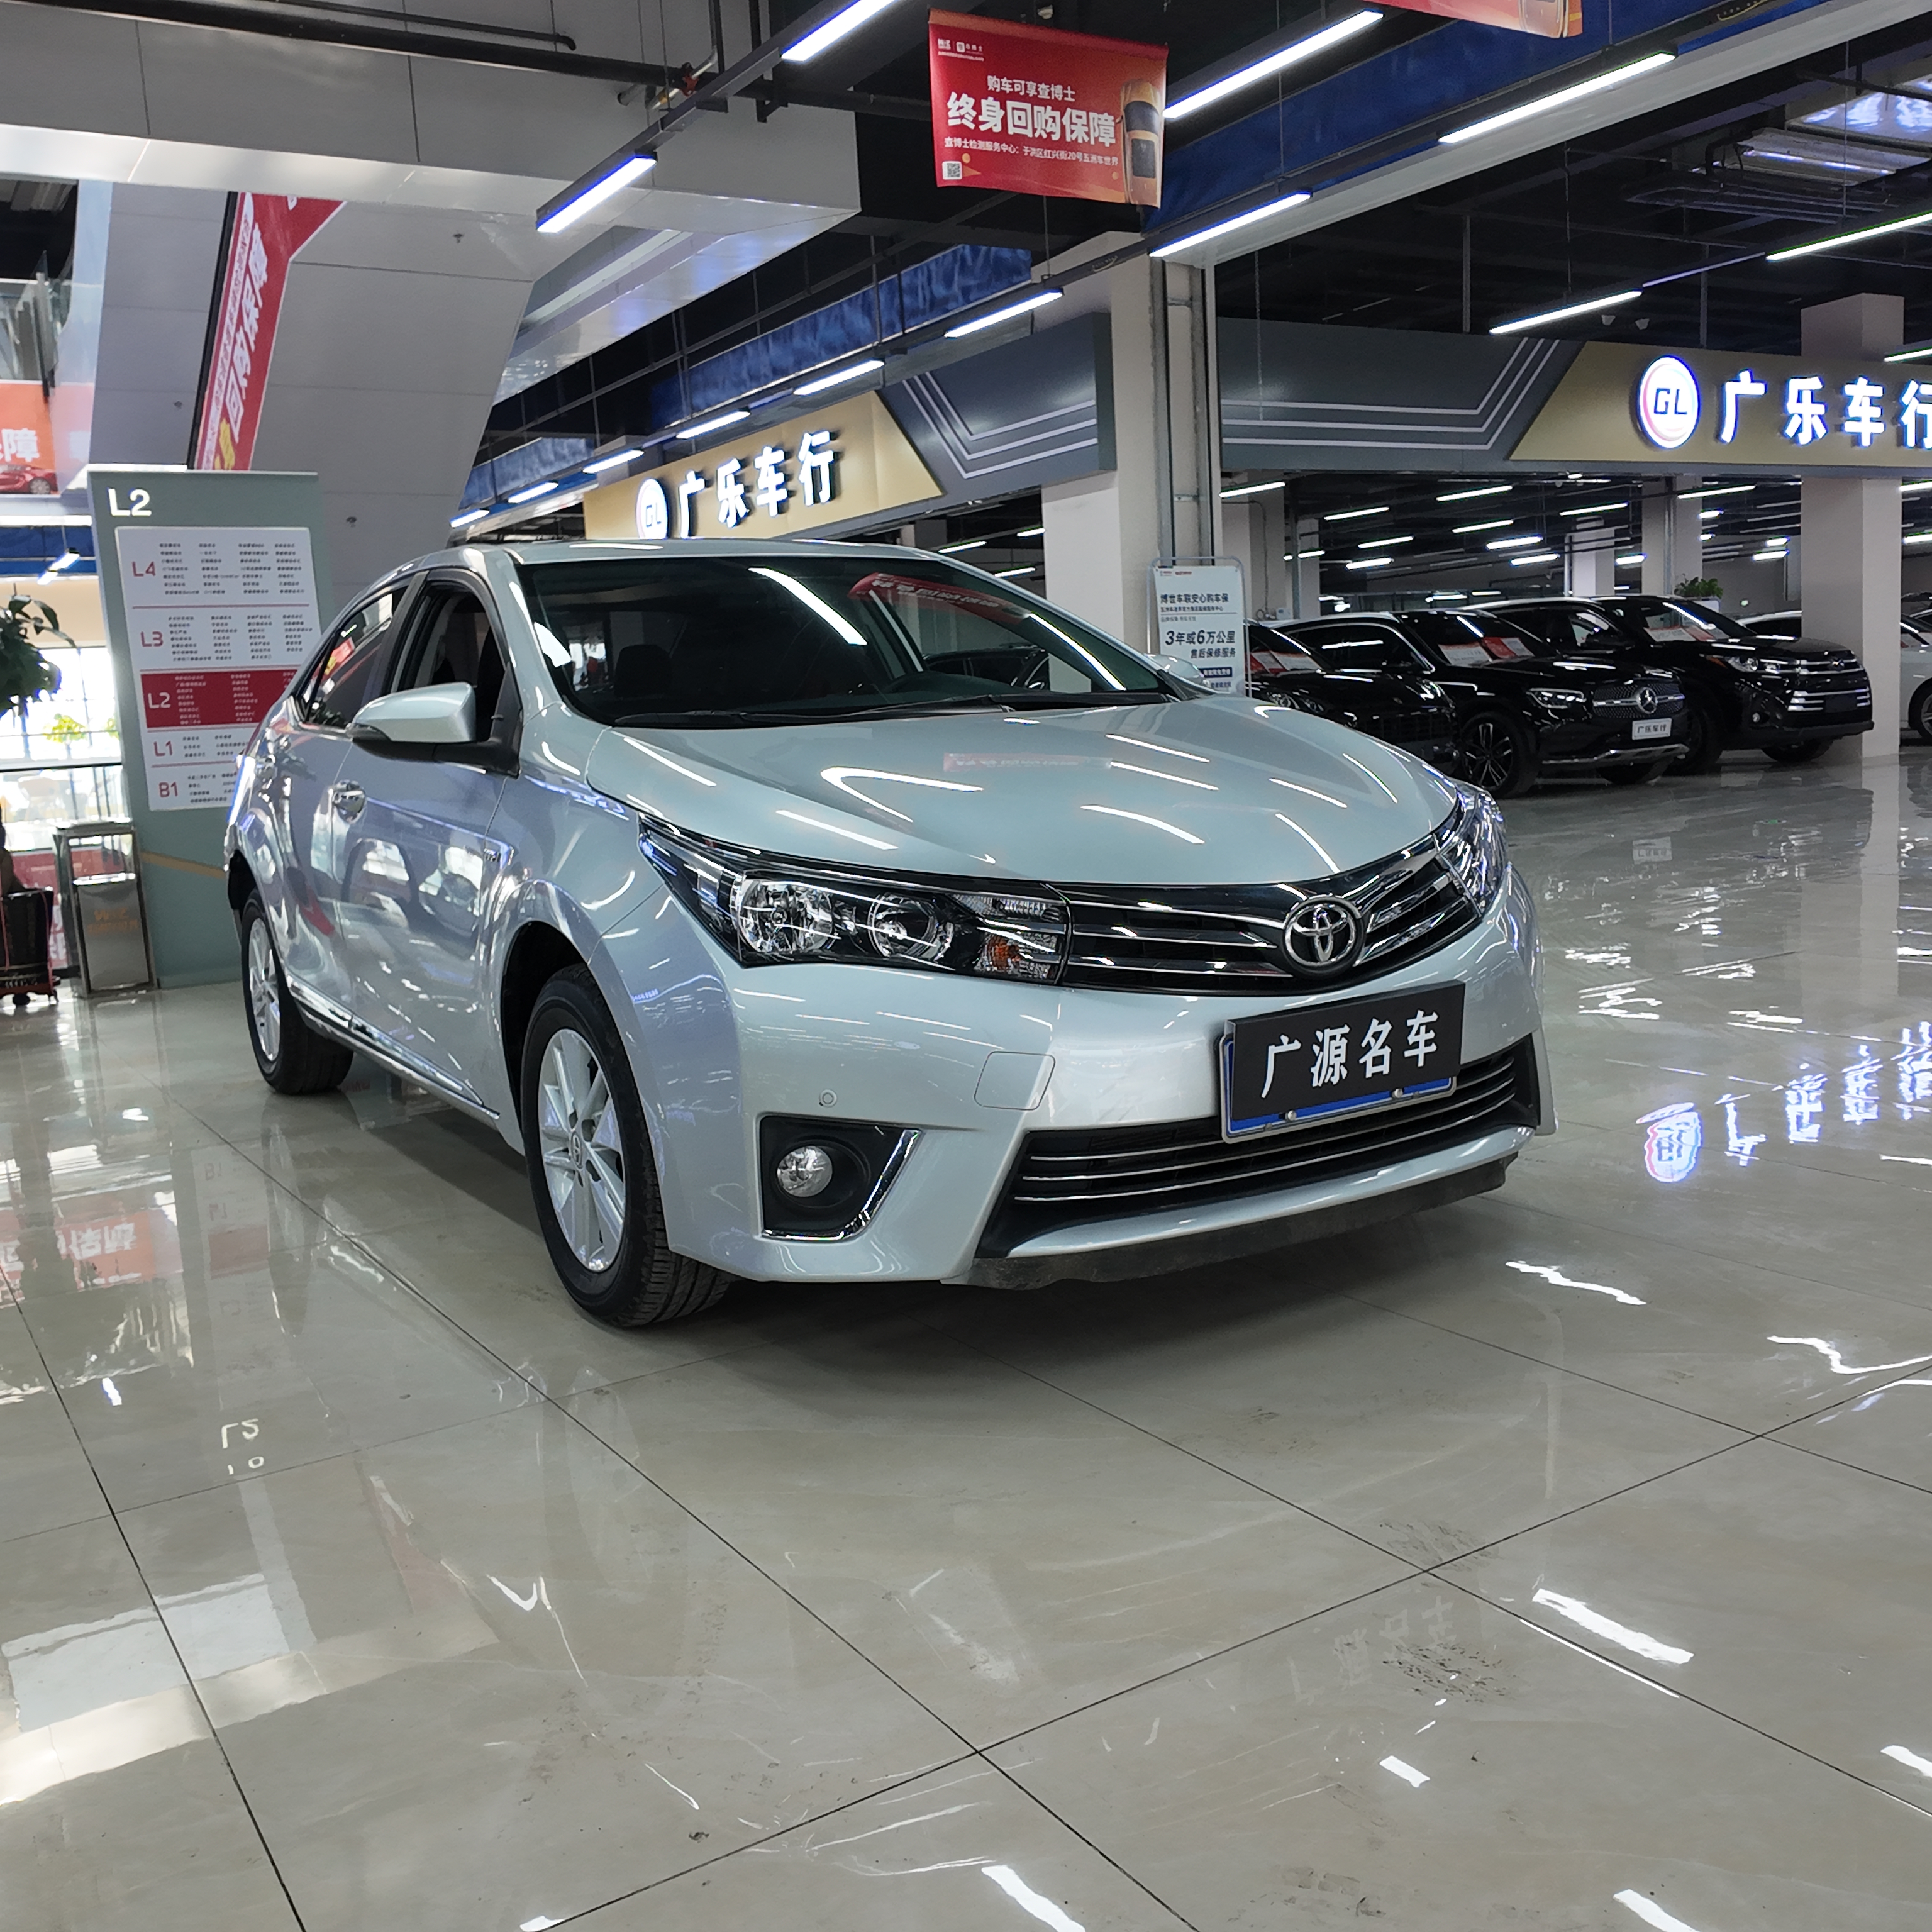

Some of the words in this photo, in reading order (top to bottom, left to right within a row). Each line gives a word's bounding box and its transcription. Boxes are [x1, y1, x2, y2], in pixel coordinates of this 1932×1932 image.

[987, 75, 1075, 102] 购车可享查博士
[947, 91, 1116, 147] 终身回购保障
[214, 222, 268, 470] 身回购保障
[1653, 387, 1688, 415] GL
[1719, 369, 1932, 449] 广乐车行
[0, 428, 40, 463] 障
[679, 431, 835, 538] 广乐车行
[108, 487, 152, 517] L2
[132, 562, 156, 578] L4
[141, 631, 164, 648] L3
[1165, 630, 1236, 645] 3年或6万公里
[148, 692, 171, 709] L2
[154, 741, 174, 757] L1
[158, 782, 179, 798] B1
[1260, 1009, 1439, 1099] 广源名车
